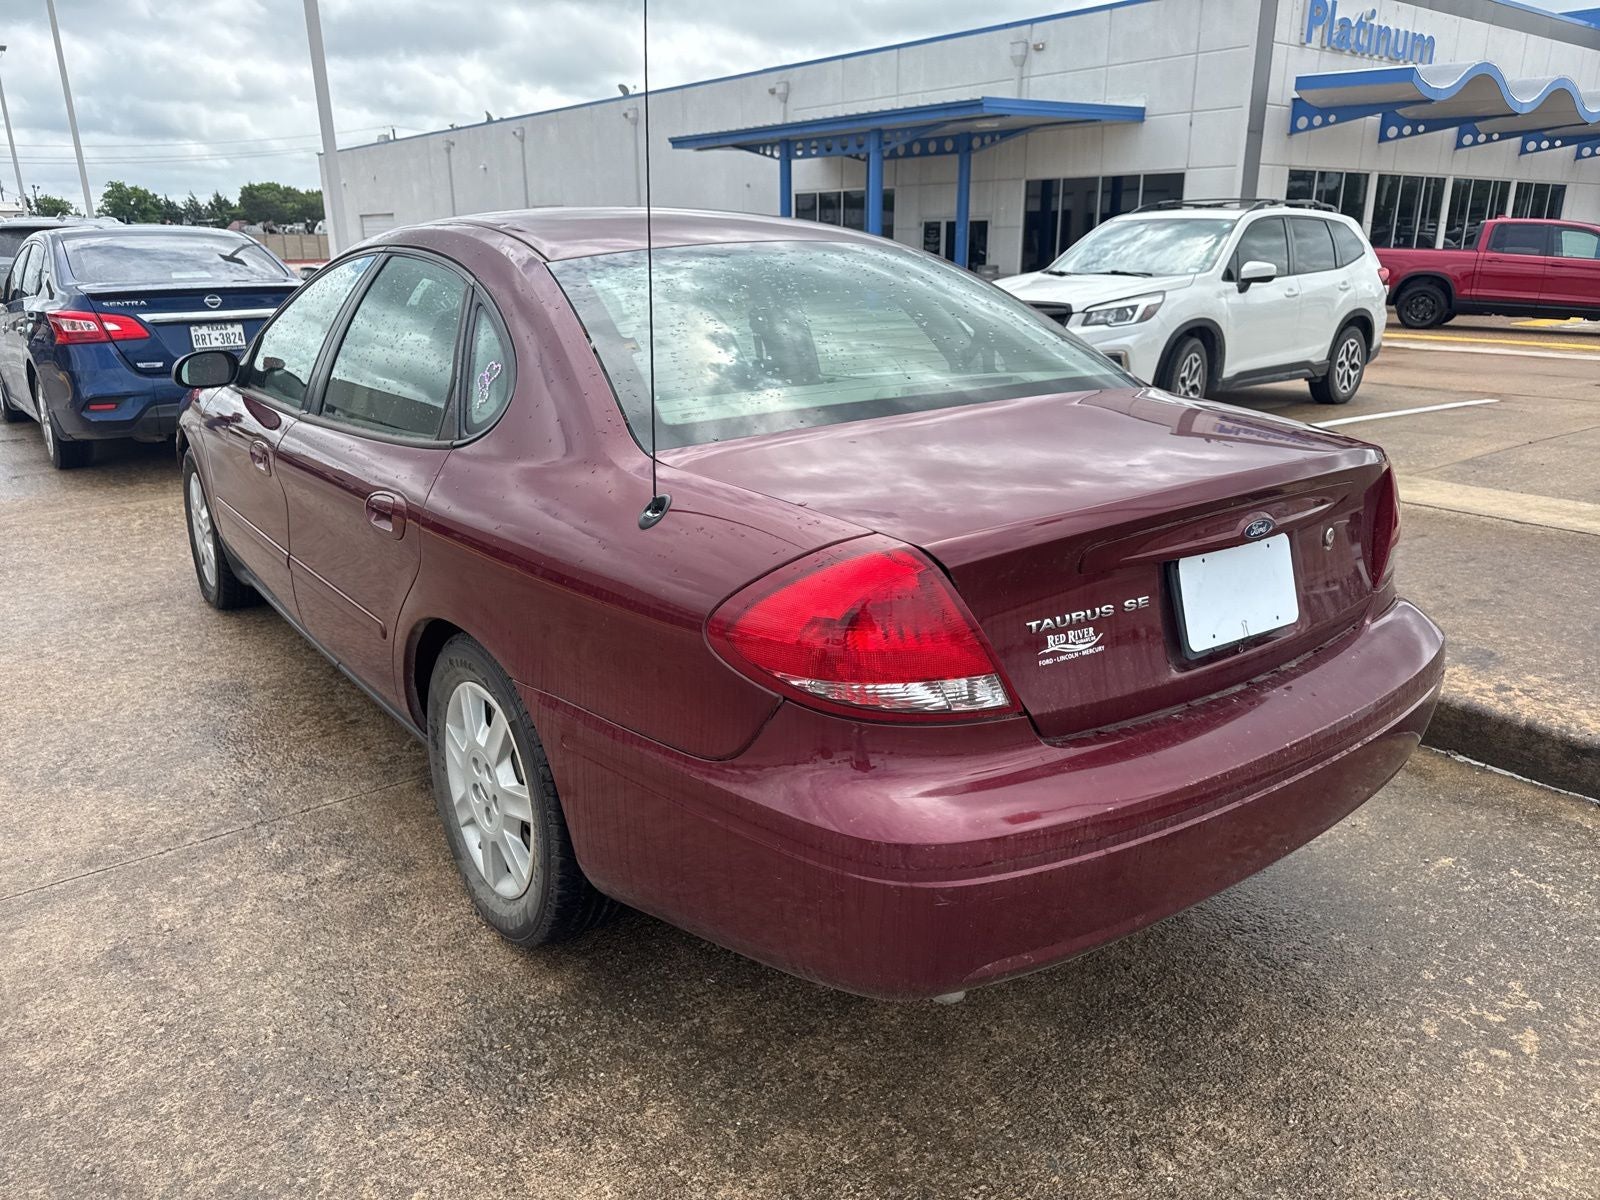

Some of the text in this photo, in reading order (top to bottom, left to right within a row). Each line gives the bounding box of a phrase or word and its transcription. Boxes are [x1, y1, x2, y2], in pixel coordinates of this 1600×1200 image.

[1304, 0, 1436, 65] Platinum
[1249, 521, 1269, 537] Ford
[1026, 595, 1150, 634] TAURUS SE
[1046, 631, 1067, 649] RED
[1067, 626, 1096, 644] RIVER
[1038, 645, 1106, 667] FORD LINCOLN MERCURY
